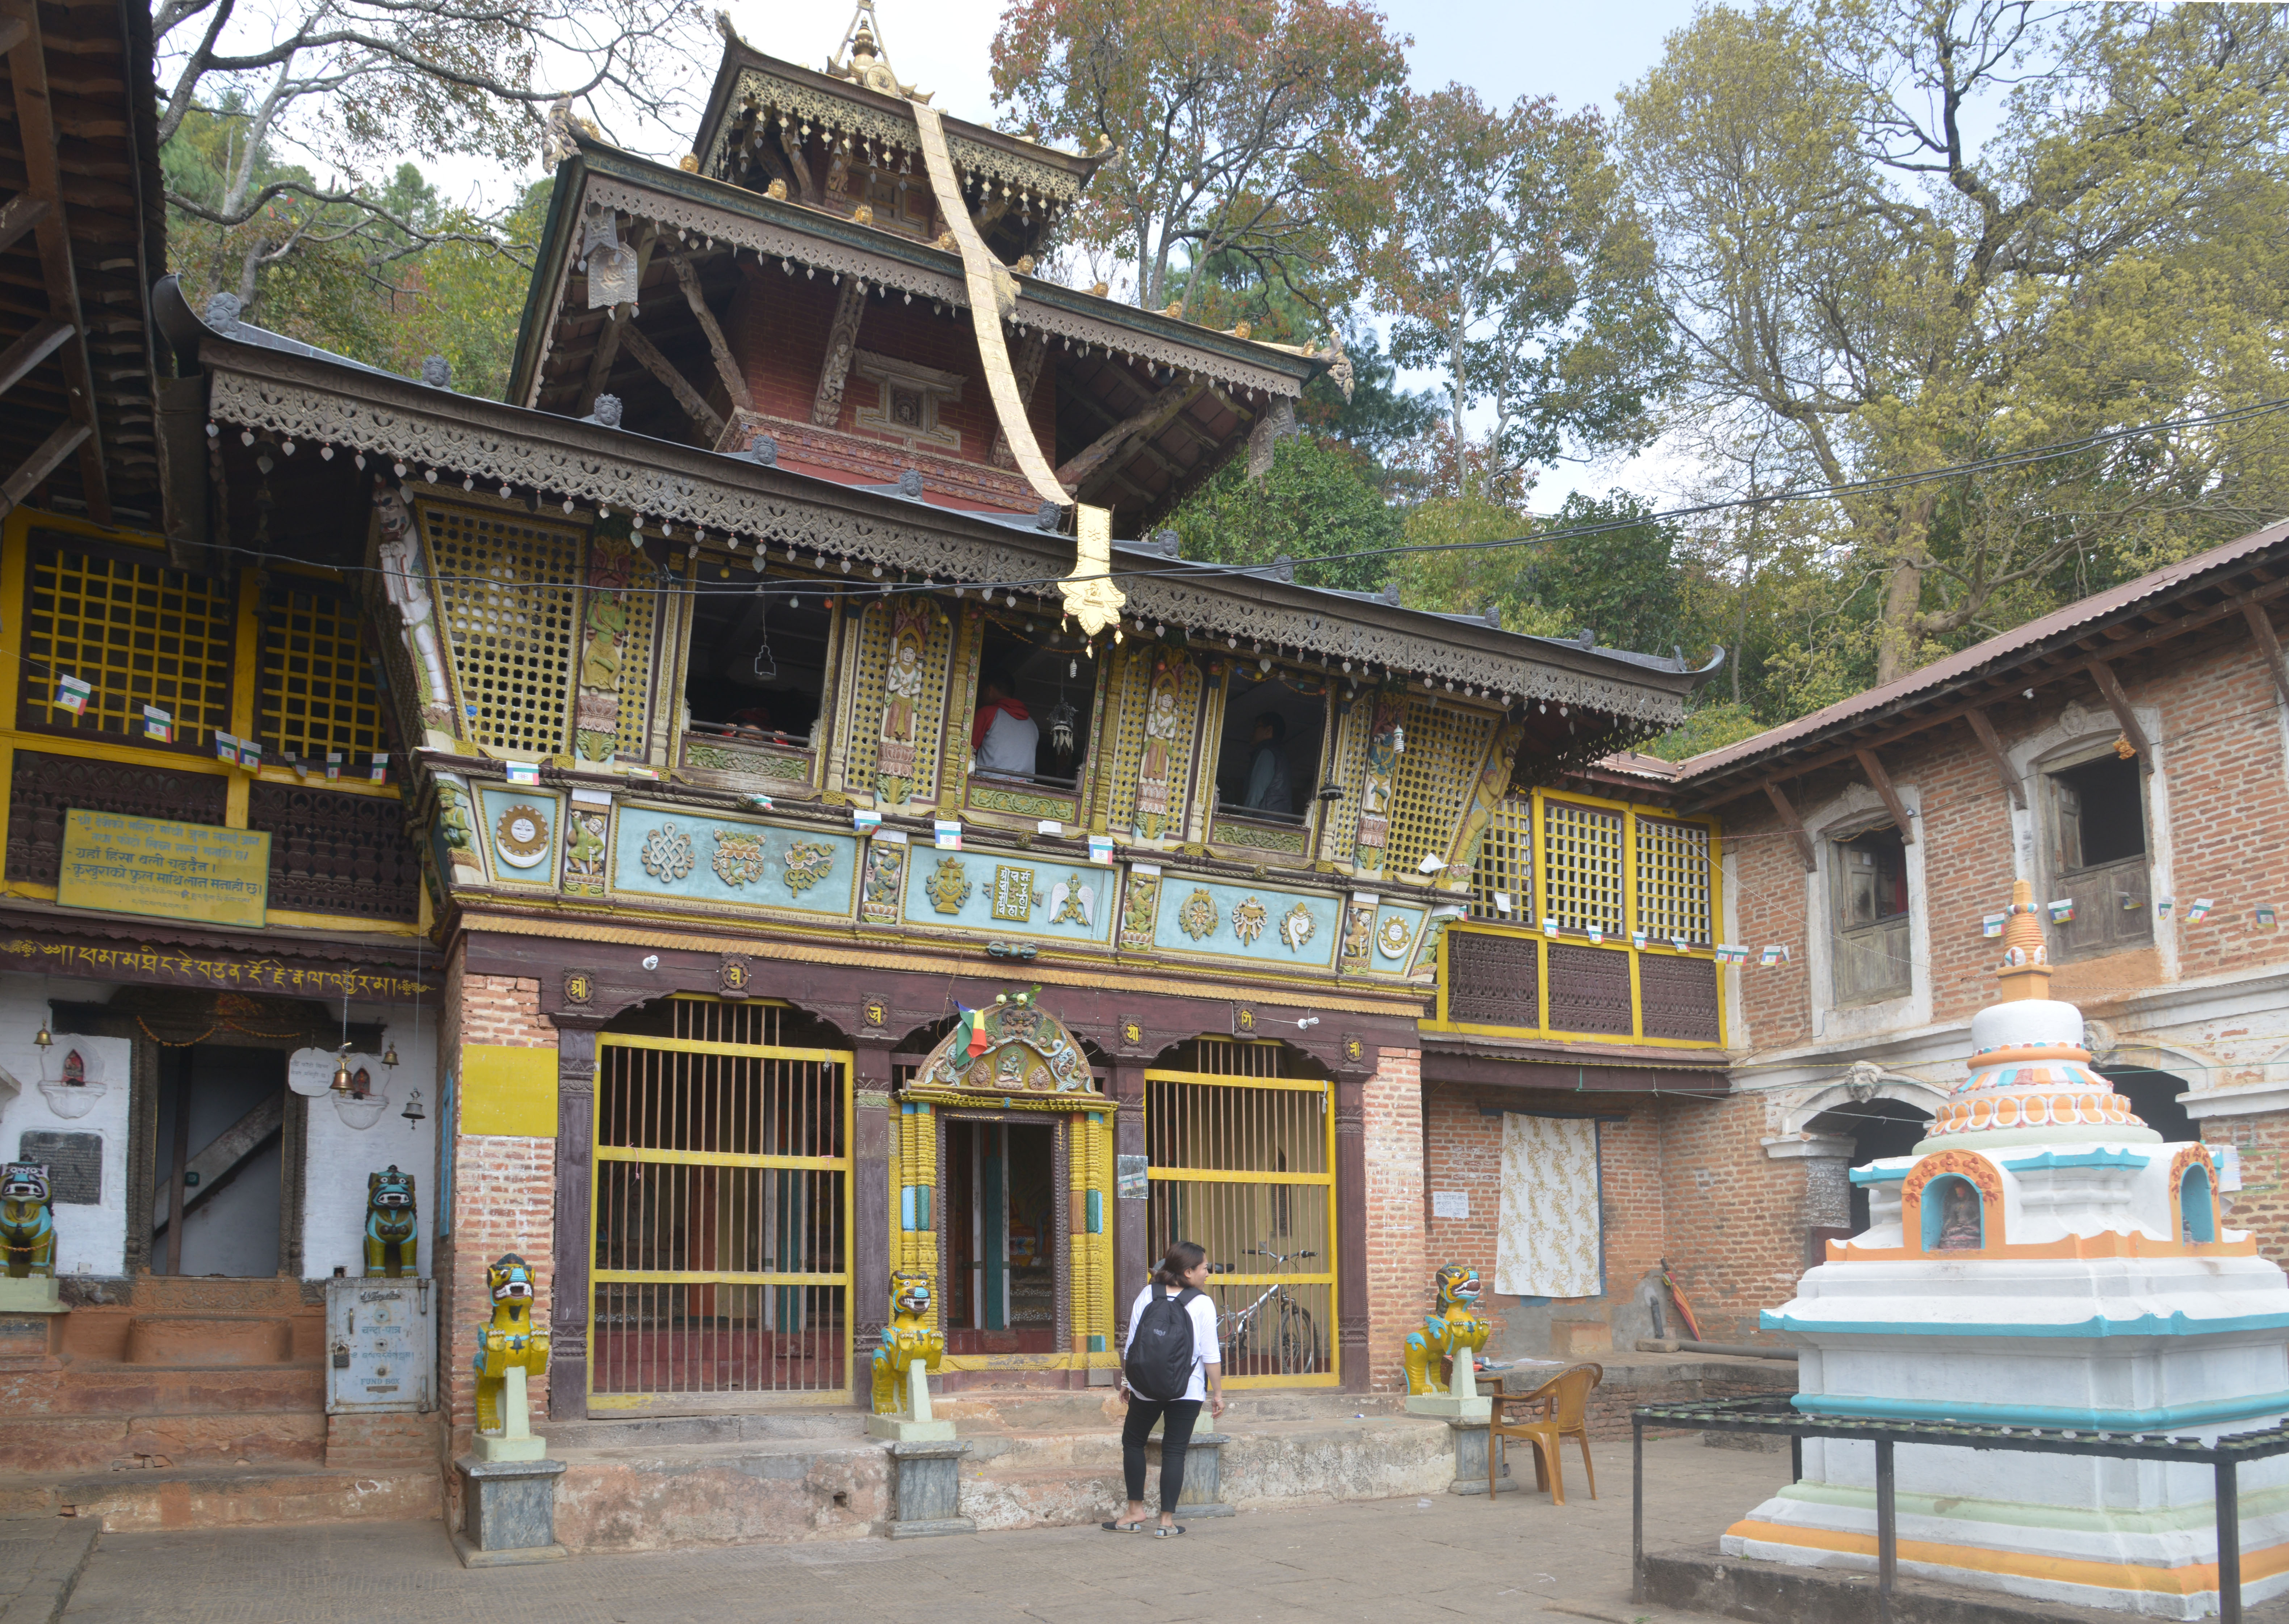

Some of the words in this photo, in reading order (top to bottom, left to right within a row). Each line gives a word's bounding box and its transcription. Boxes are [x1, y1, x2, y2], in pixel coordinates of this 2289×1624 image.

[117, 833, 141, 847] फोटो
[76, 846, 101, 859] यहाँ
[105, 847, 135, 863] हिंसा
[139, 853, 165, 867] बली
[71, 863, 127, 880] कुखुराको
[129, 869, 155, 884] फुल
[156, 871, 184, 886] माथि
[184, 876, 208, 888] लान
[210, 878, 244, 892] मनाही
[571, 977, 586, 998] श्री
[730, 968, 740, 985] व
[1241, 1011, 1252, 1027] गि
[1350, 1042, 1359, 1057] नी
